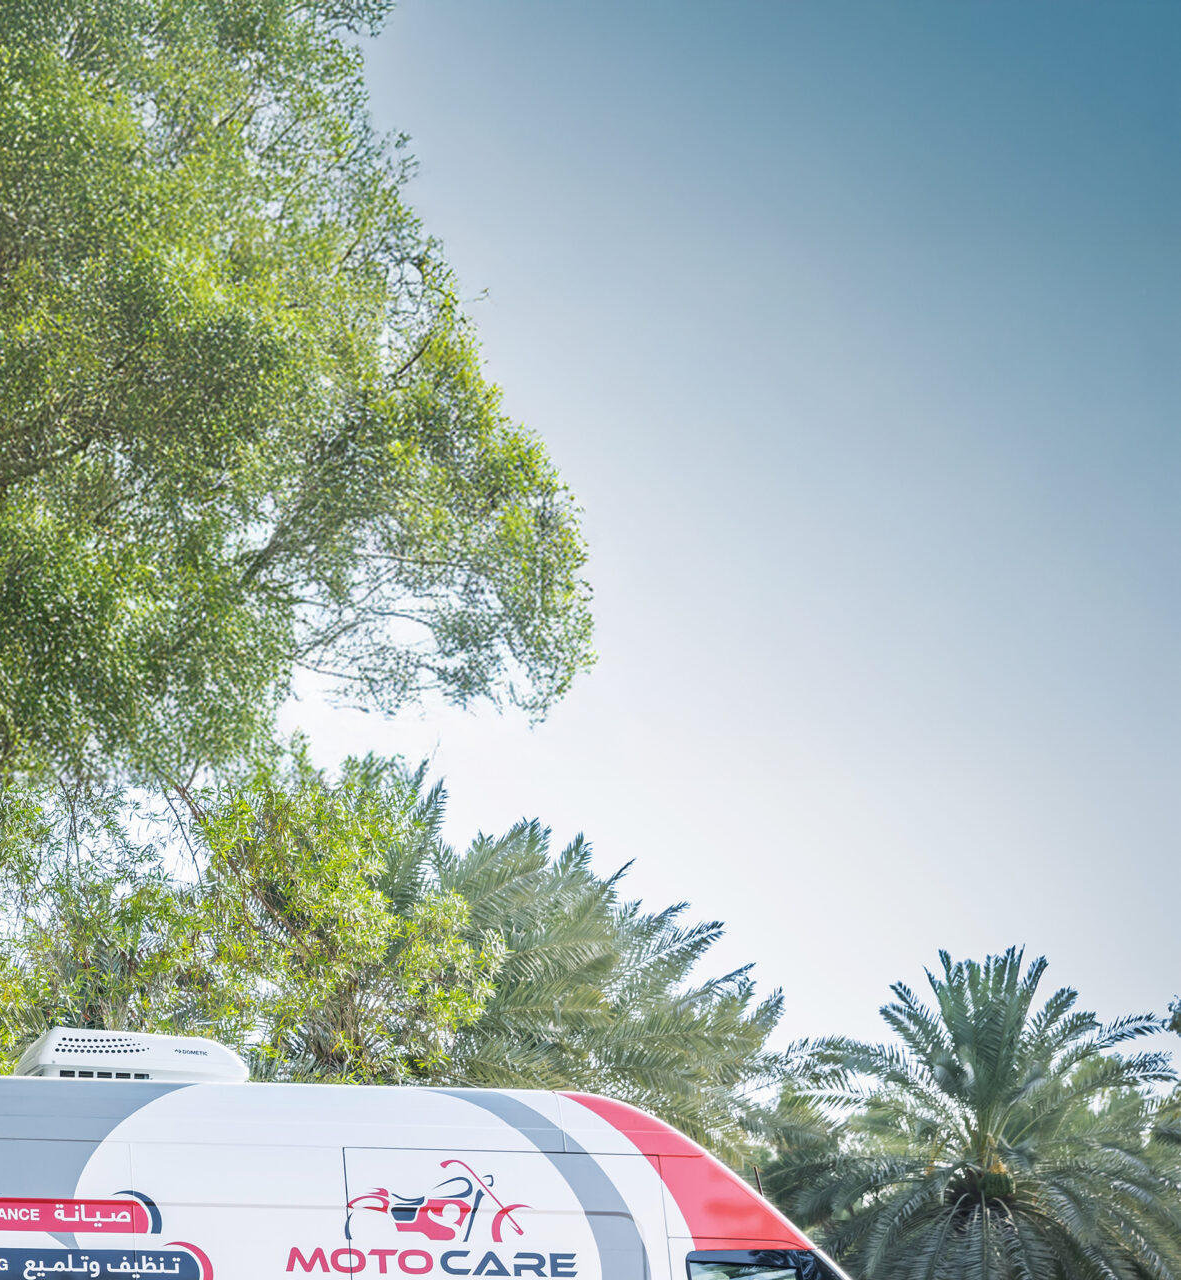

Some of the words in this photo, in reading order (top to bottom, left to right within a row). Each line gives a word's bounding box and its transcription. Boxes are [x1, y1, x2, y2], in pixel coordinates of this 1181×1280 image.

[54, 1204, 131, 1228] صيانة
[22, 1254, 101, 1280] وتلميع
[106, 1256, 181, 1279] تنظيف
